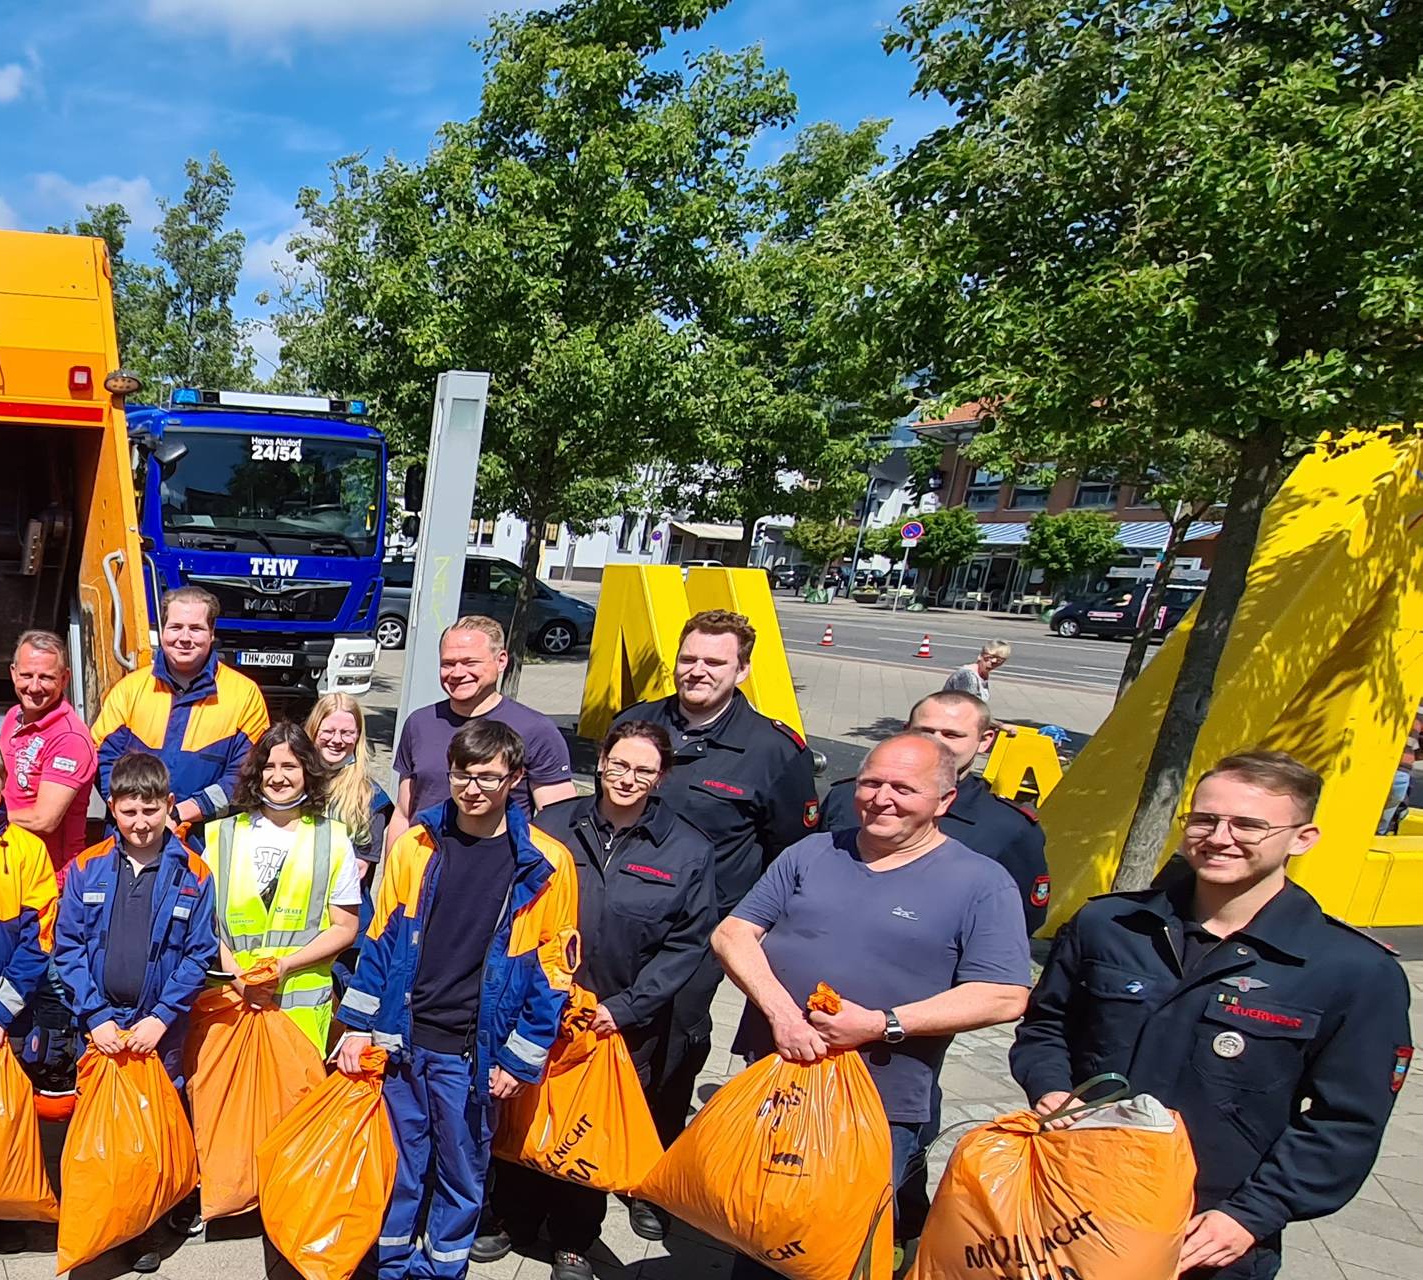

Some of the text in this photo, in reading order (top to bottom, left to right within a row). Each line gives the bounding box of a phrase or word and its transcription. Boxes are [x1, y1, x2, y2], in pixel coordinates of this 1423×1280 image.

[251, 436, 303, 448] Heros Alsdorf
[251, 444, 303, 462] 24/54
[249, 557, 299, 577] THW
[243, 598, 296, 612] MAN
[243, 653, 292, 665] THW 90948
[1224, 1003, 1304, 1029] FEUERWEHR
